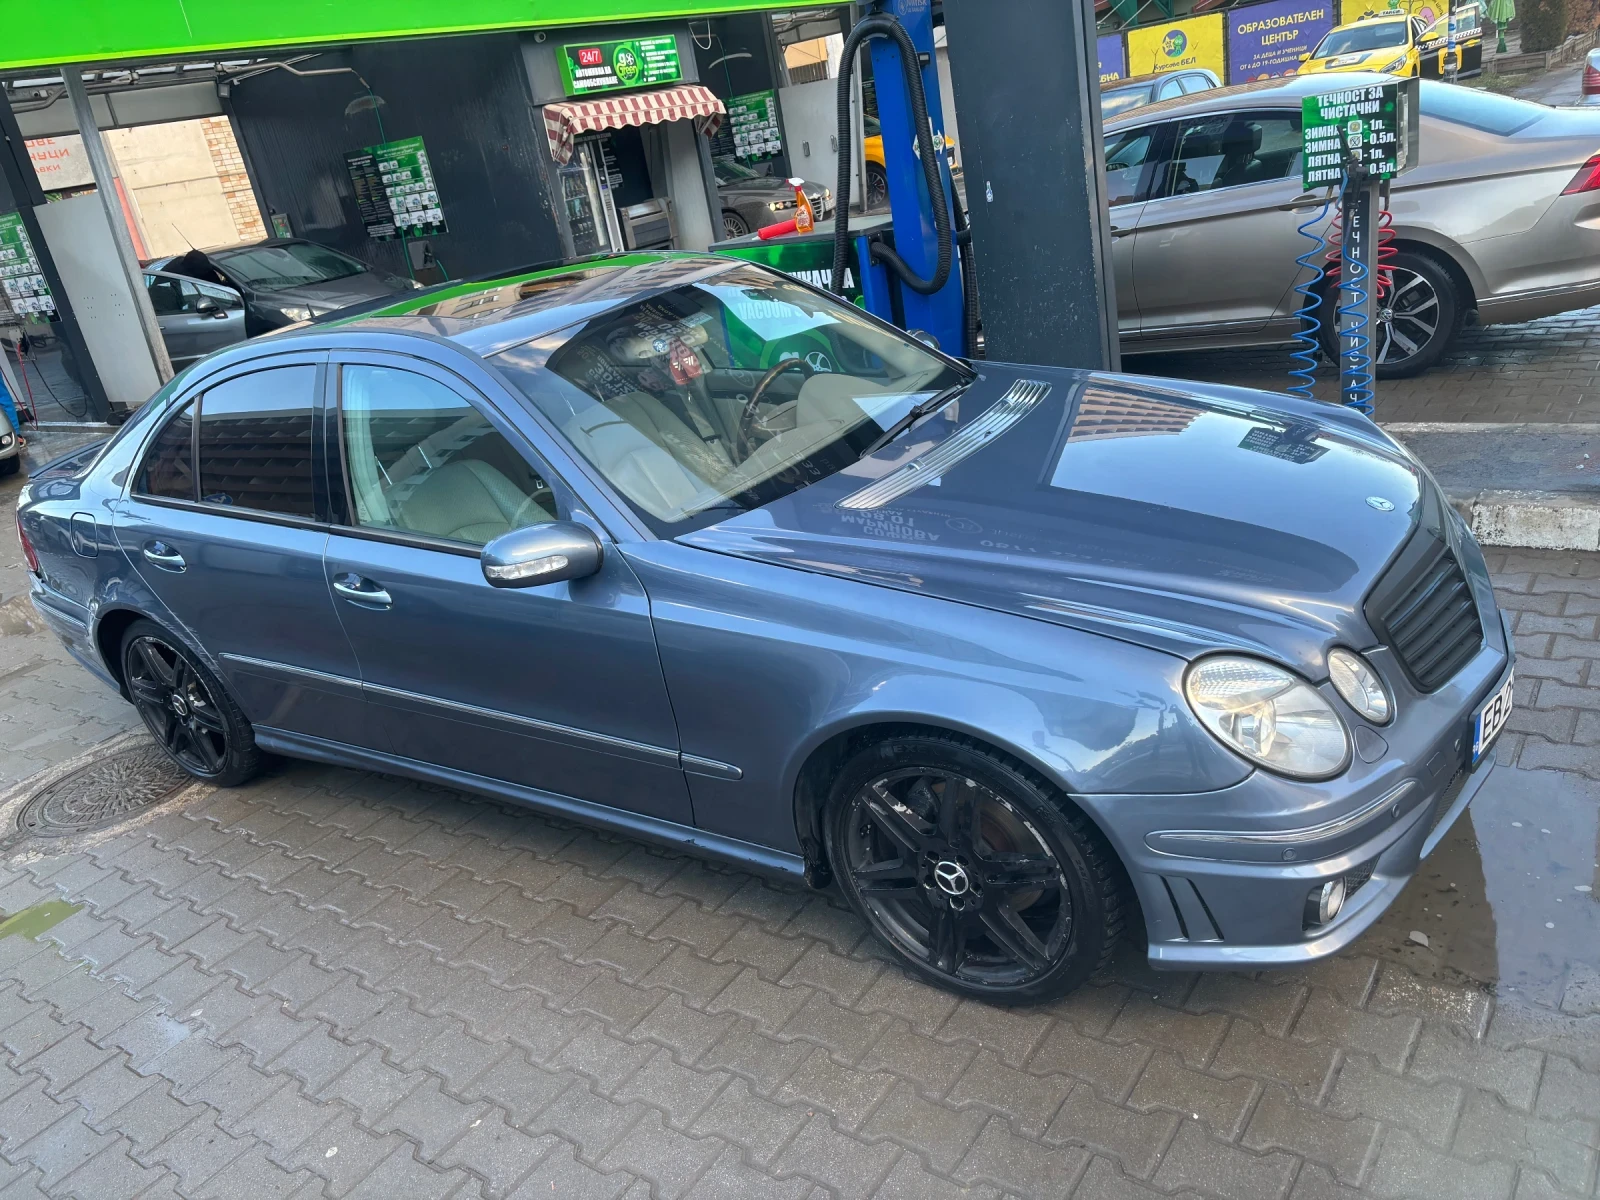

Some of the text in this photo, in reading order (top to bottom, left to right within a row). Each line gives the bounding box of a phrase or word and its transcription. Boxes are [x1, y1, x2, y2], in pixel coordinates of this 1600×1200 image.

[1237, 9, 1324, 35] ОБРАЗОВАТЕЛЕН
[1261, 29, 1299, 46] ЦЕНТЪР
[581, 51, 599, 63] 24/7
[1180, 56, 1197, 66] БЕЛ
[1261, 51, 1276, 59] ДЕЦА
[1240, 63, 1247, 71] ОТ
[1252, 61, 1261, 69] ДО
[1099, 72, 1120, 83] БНА
[1317, 86, 1384, 107] ТЕЧНОСТ ЗА
[1320, 100, 1380, 120] ЧИСТАЧКИ
[1370, 119, 1386, 131] 1л.
[1304, 132, 1397, 154] ЗИМНА 0.5л.
[1307, 148, 1385, 168] ЛЯТНА 1л.
[1308, 162, 1397, 182] ЛЯТНА 0.5л.
[1350, 201, 1361, 303] ЕЧНОСТ
[1483, 695, 1502, 744] EB
